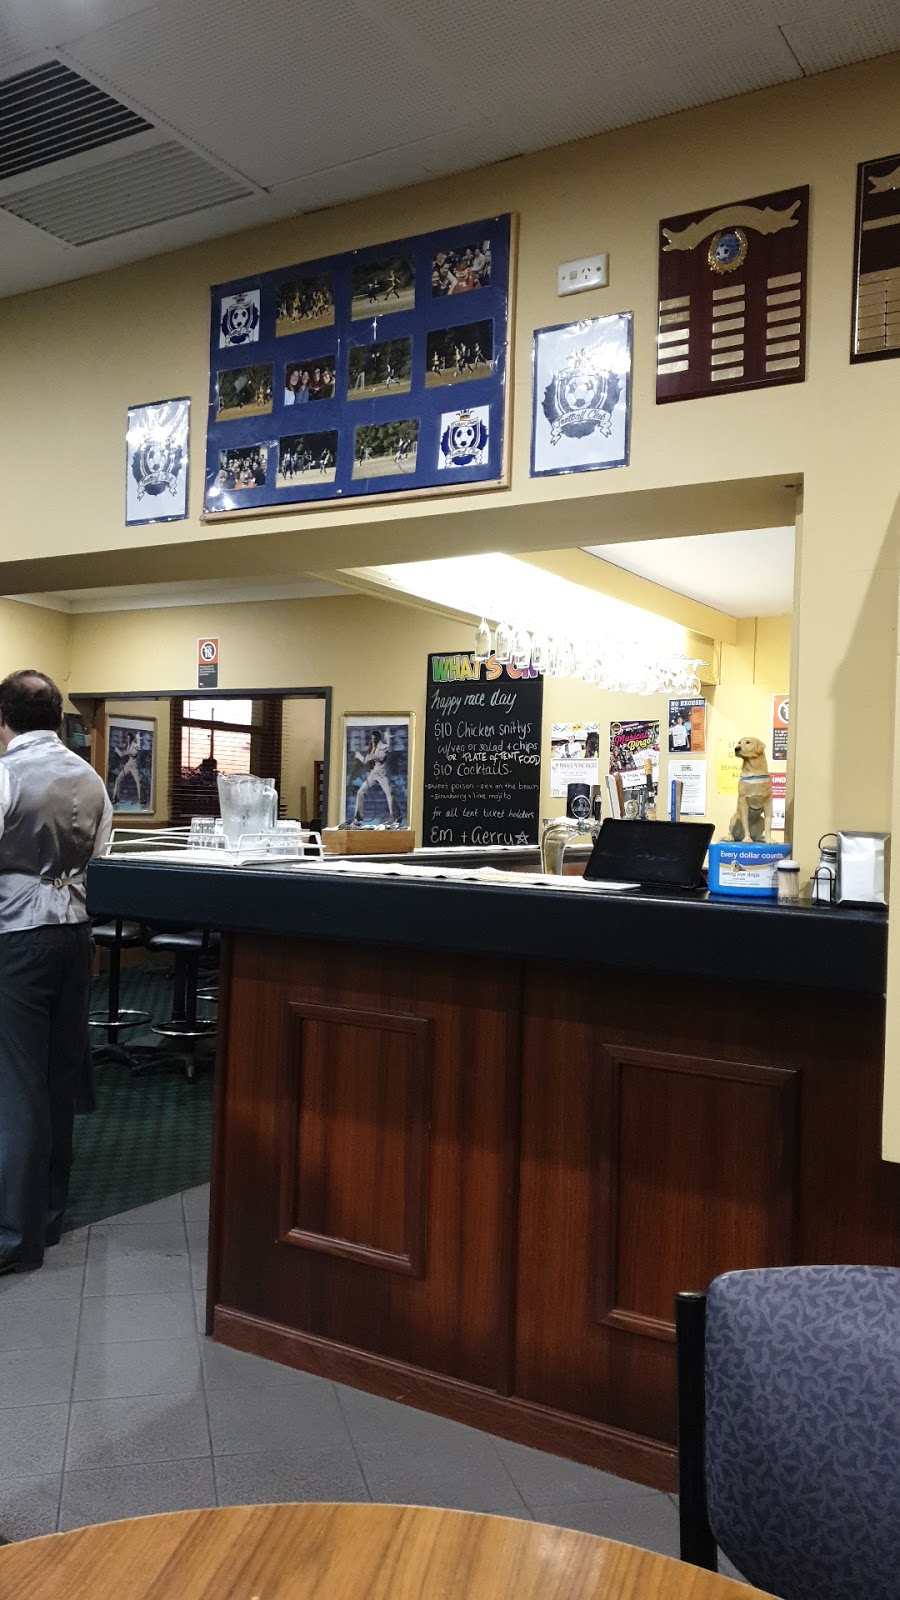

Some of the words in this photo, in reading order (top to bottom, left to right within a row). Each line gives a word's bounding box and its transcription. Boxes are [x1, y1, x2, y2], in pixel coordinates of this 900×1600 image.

[588, 409, 606, 422] Club
[432, 654, 503, 682] WHATS
[431, 688, 462, 716] happy
[463, 693, 485, 706] race
[491, 688, 517, 714] day
[434, 719, 453, 741] $10
[457, 720, 495, 738] Chicken
[614, 731, 650, 746] Musical
[468, 742, 478, 750] or
[480, 740, 503, 752] salad
[512, 741, 539, 754] chips
[461, 752, 488, 762] PLATE
[497, 751, 520, 761] TENT
[518, 754, 541, 766] FOOD
[433, 761, 453, 780] $10
[772, 776, 786, 784] UND
[431, 806, 442, 820] for
[445, 807, 459, 818] all
[430, 826, 453, 844] Em
[720, 850, 738, 859] Every
[739, 851, 760, 859] dollar
